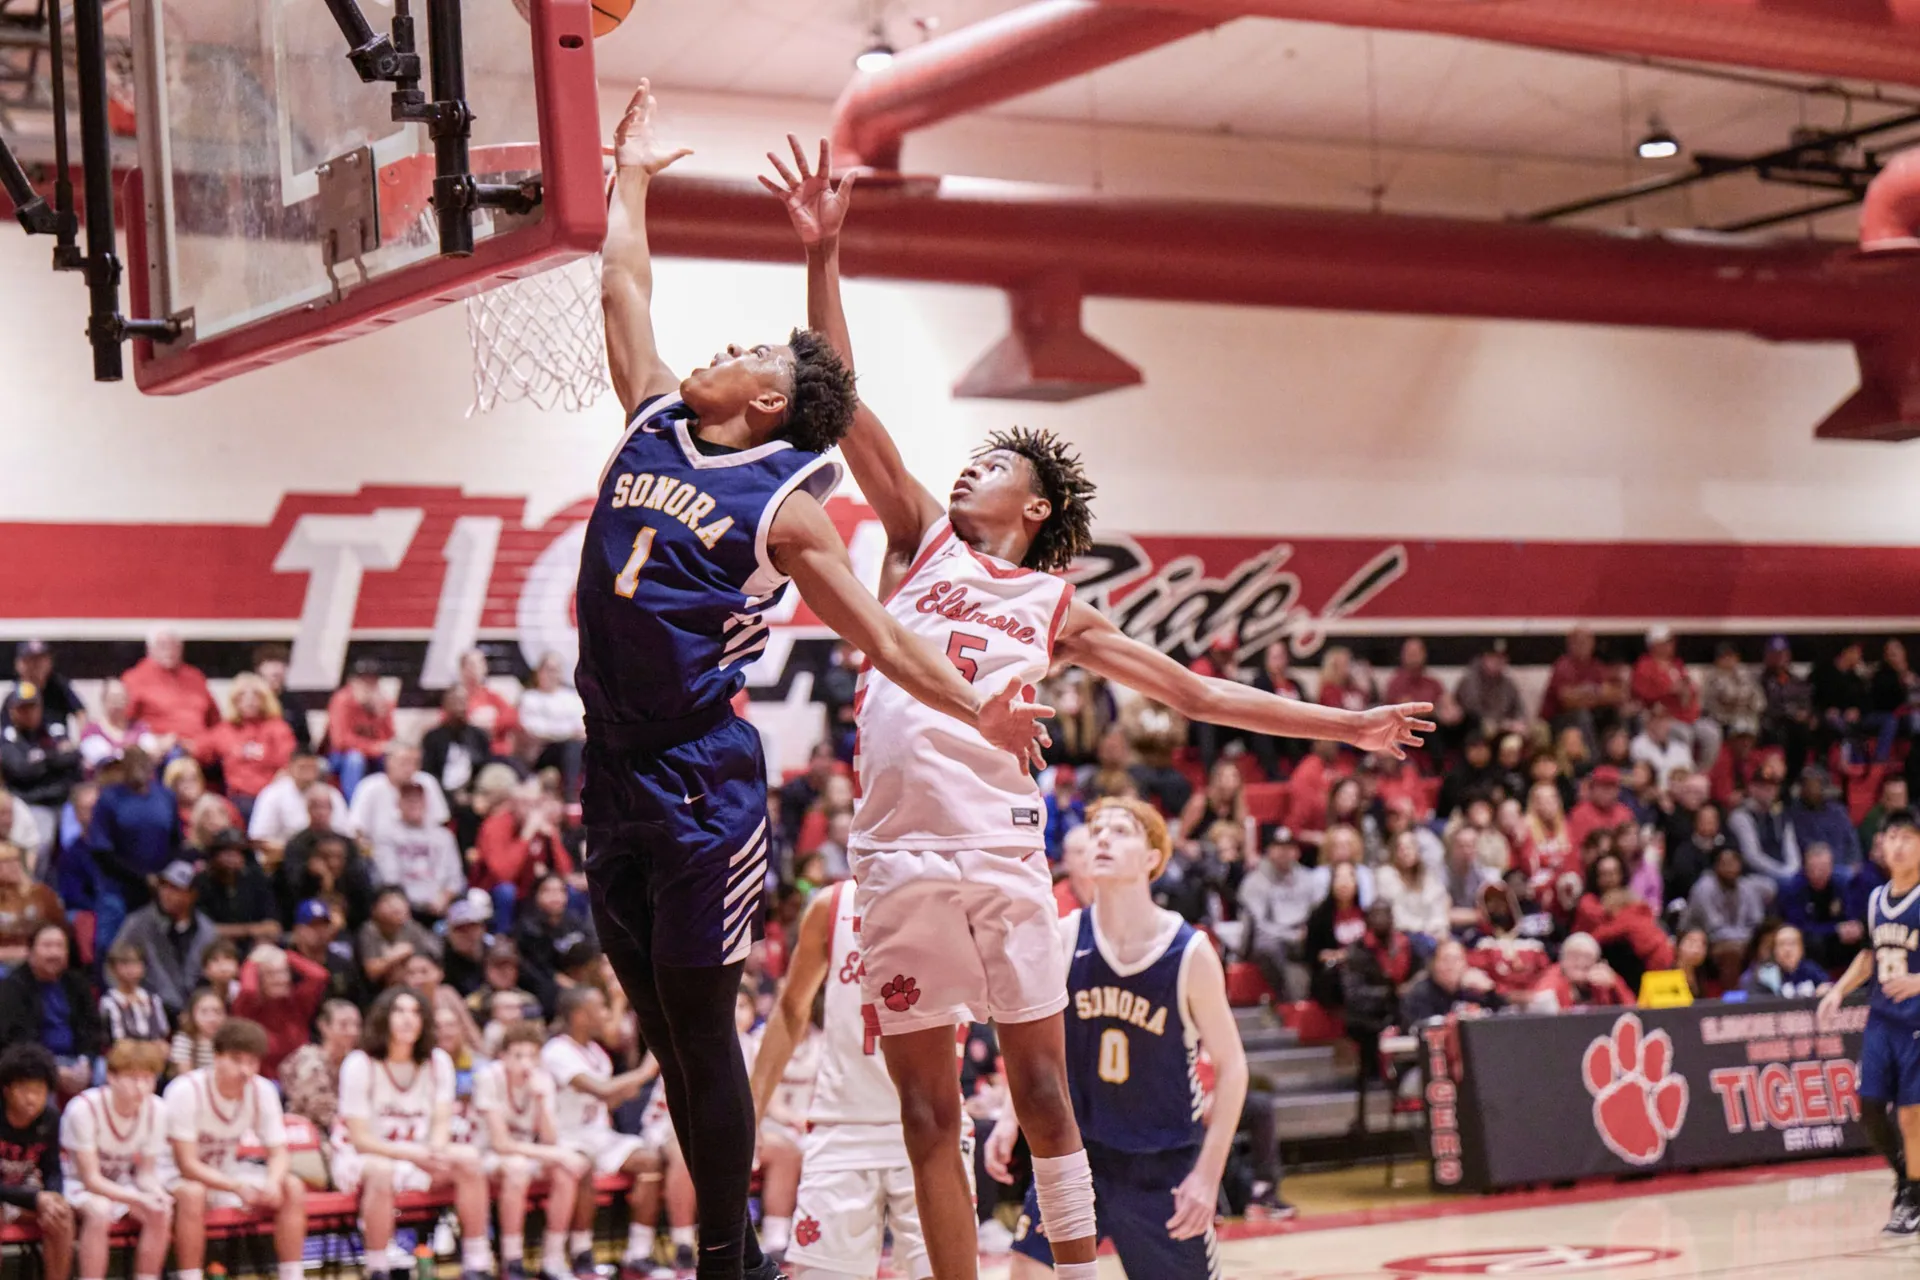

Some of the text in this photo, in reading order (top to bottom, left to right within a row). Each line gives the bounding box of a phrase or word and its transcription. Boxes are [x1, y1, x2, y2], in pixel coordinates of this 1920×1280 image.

[612, 473, 735, 550] SONORA
[615, 526, 657, 599] 1
[916, 581, 1036, 645] Elsinore
[946, 631, 988, 685] 5
[1075, 986, 1168, 1036] SONORA
[1098, 1028, 1130, 1084] 0
[1709, 1058, 1862, 1133] TIGER
